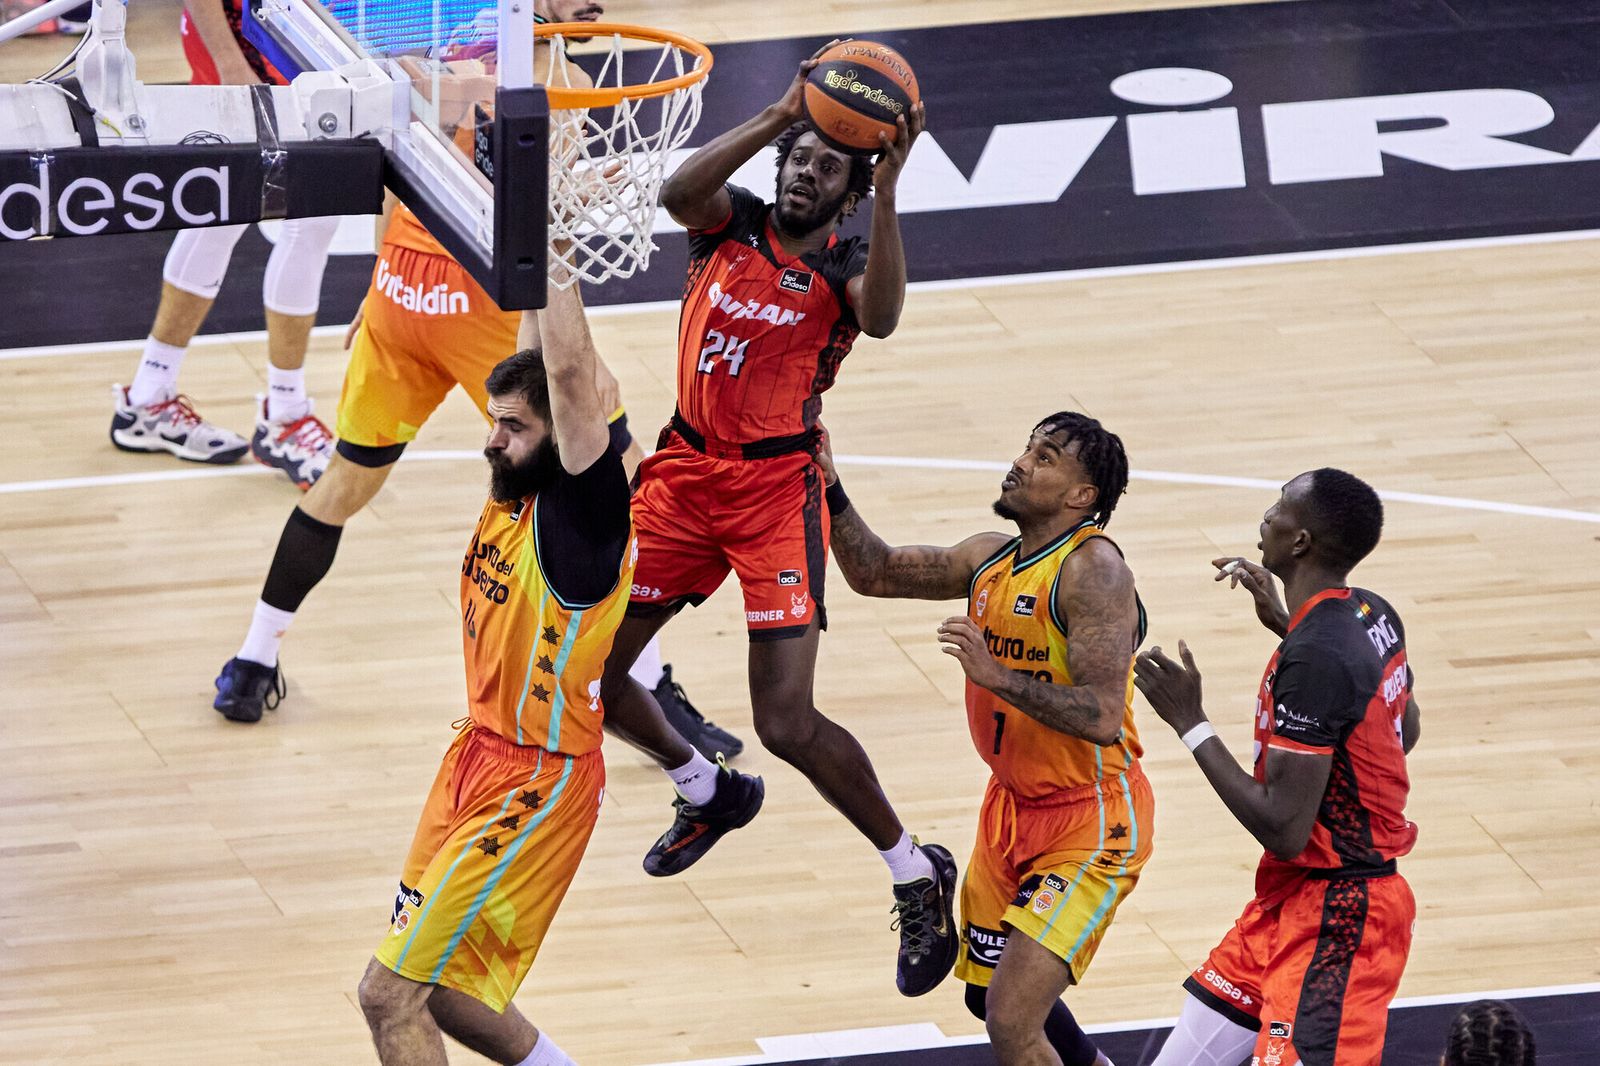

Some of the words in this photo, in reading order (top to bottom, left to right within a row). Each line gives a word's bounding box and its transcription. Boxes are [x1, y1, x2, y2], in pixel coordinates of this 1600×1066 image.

[840, 46, 912, 88] SPALDING
[698, 329, 750, 376] 24
[780, 575, 797, 584] acb
[1027, 646, 1050, 661] del
[993, 711, 1006, 755] 1
[1046, 878, 1062, 890] acb
[970, 927, 1008, 947] PULE
[1204, 969, 1243, 1000] asisa
